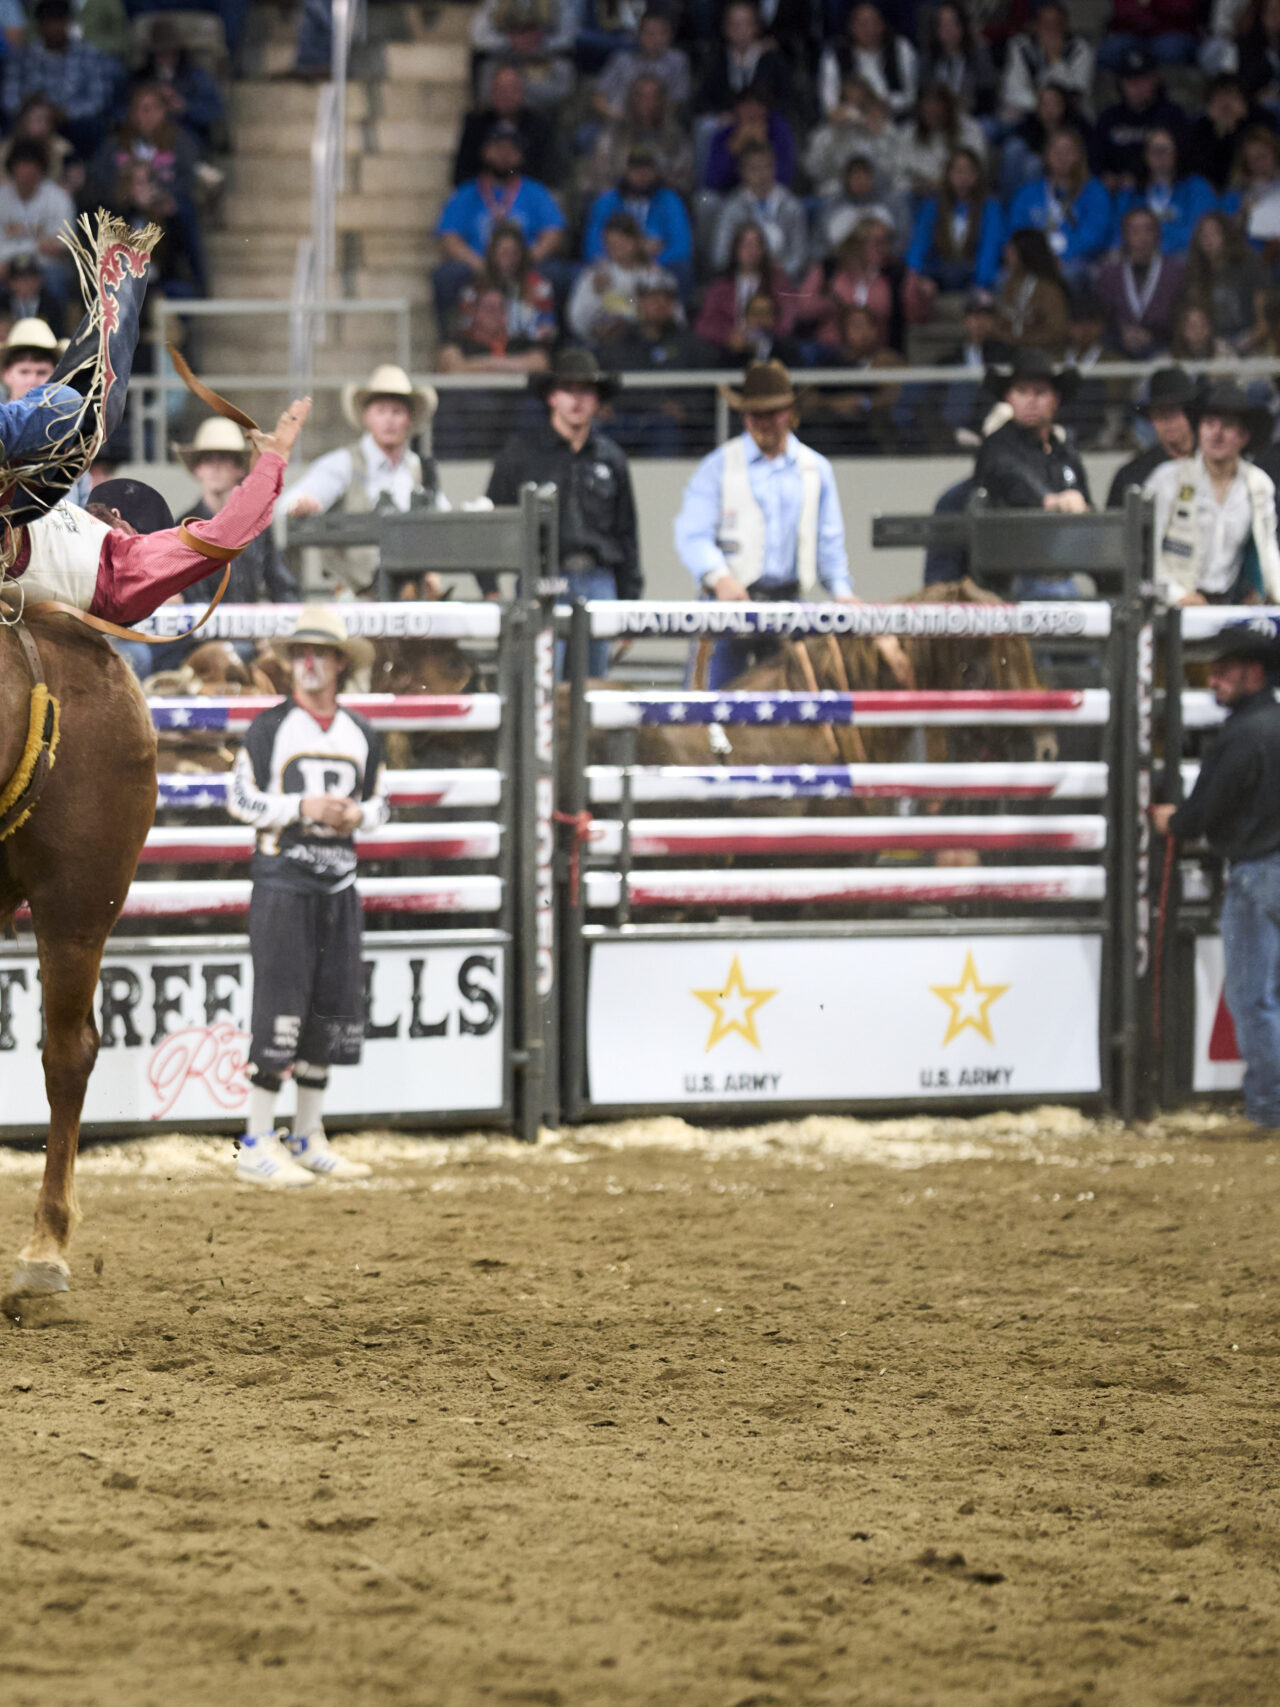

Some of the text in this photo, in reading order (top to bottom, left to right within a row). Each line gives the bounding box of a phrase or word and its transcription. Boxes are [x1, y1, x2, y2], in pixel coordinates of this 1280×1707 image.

[621, 606, 755, 634] NATIONAL
[723, 1071, 782, 1092] ARMY
[958, 1064, 1015, 1088] ARMY
